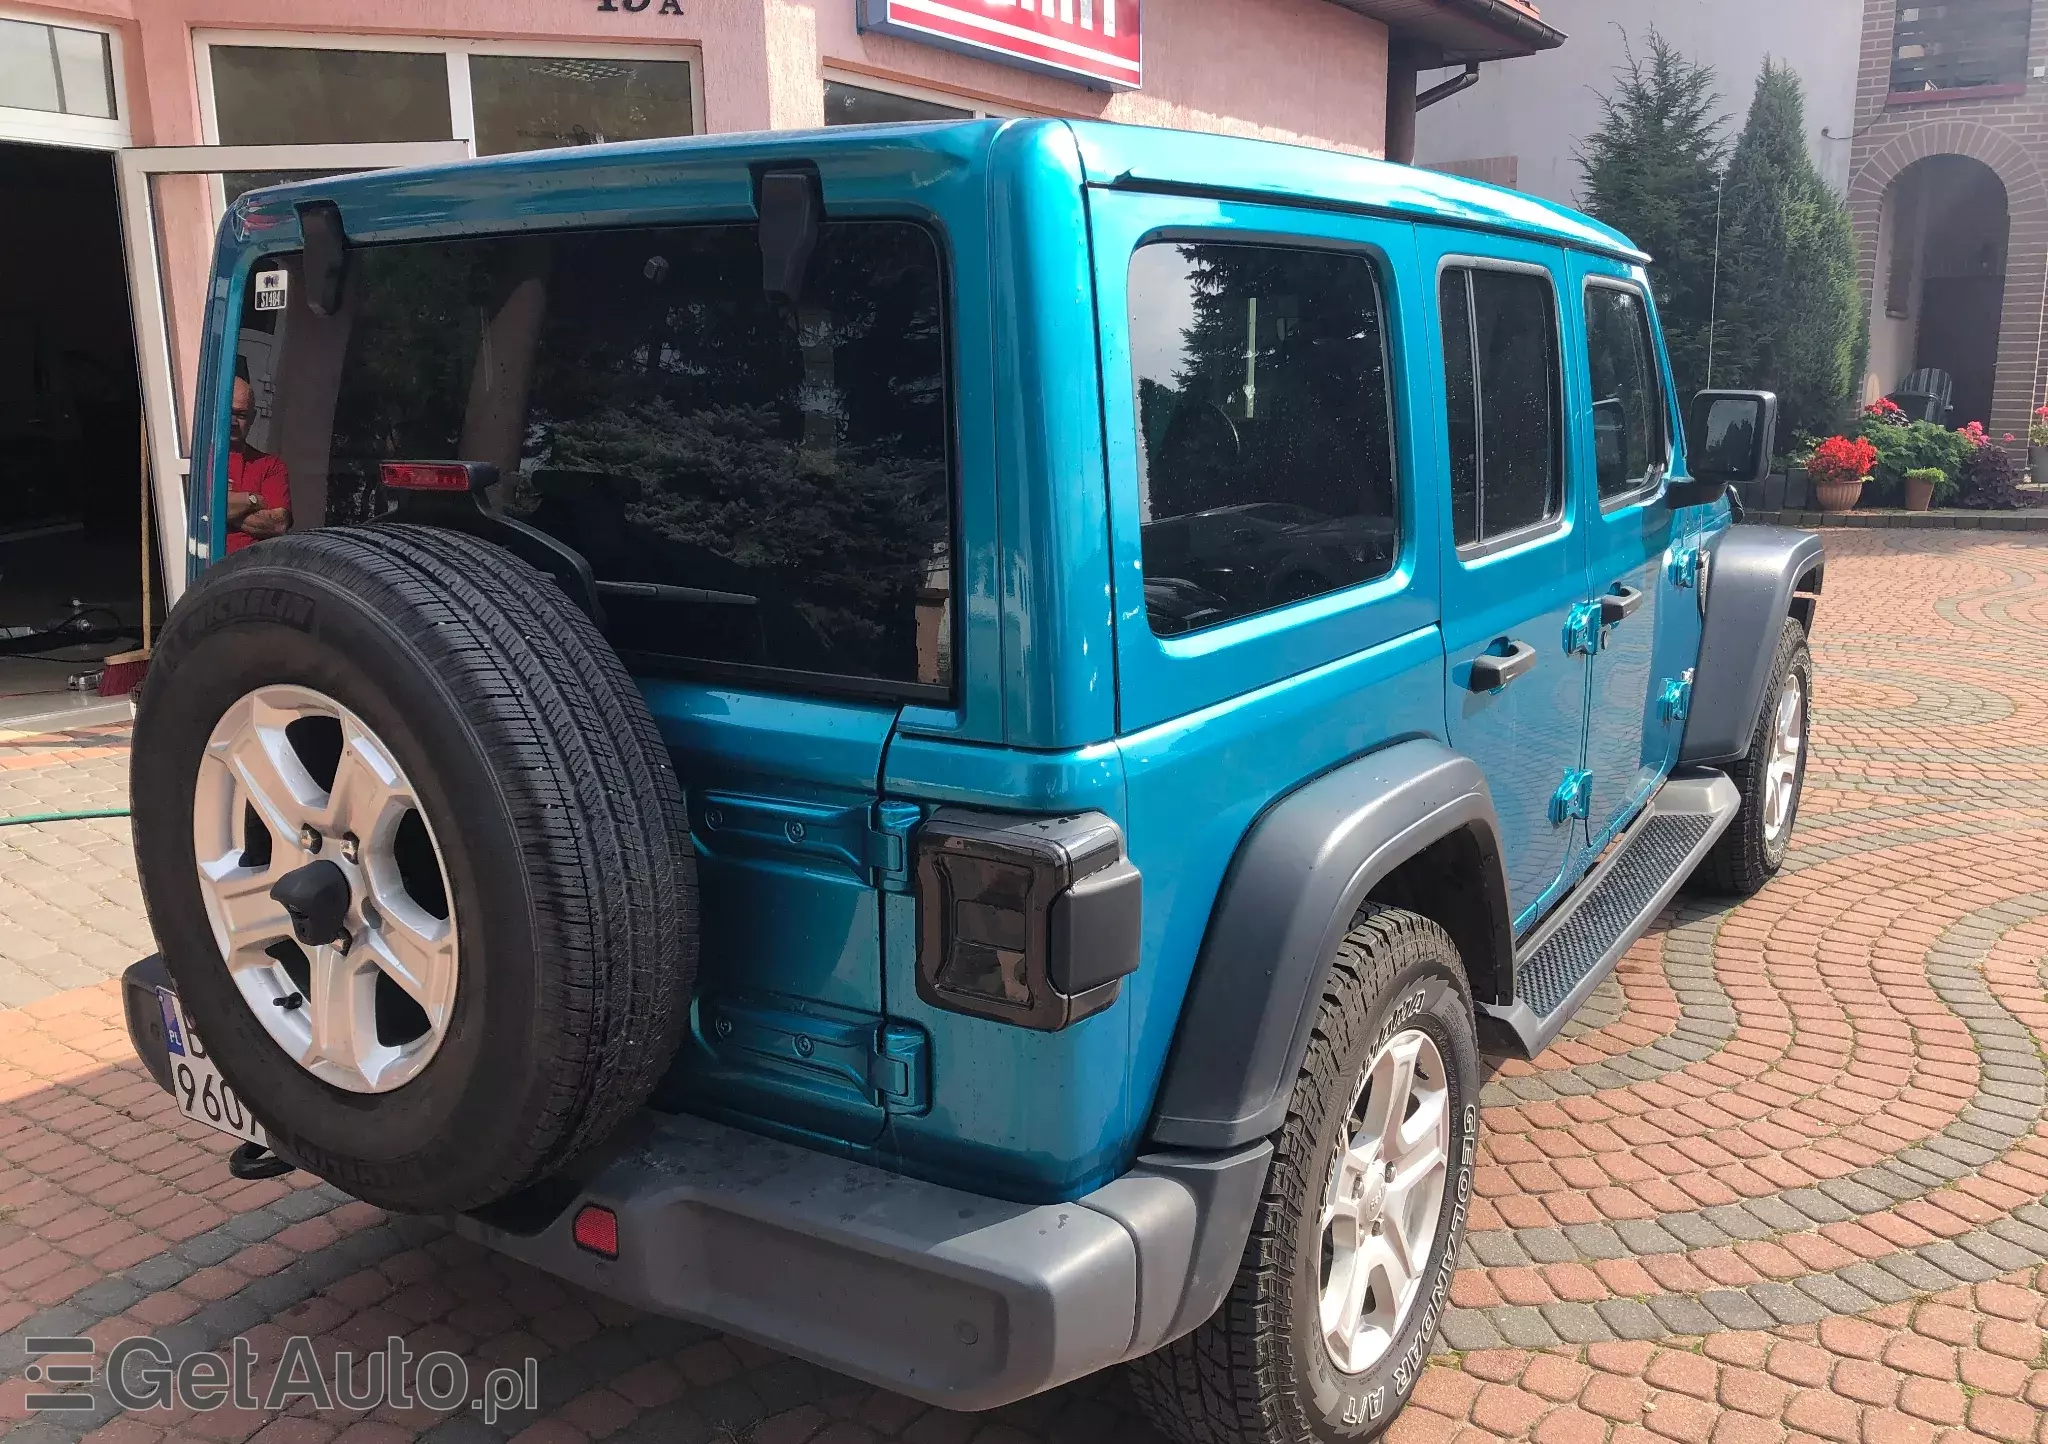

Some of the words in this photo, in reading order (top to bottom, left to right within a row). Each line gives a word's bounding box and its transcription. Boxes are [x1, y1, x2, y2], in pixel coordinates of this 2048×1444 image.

[169, 1029, 182, 1047] PL
[1393, 1103, 1477, 1396] GEOLANDAR
[1342, 1386, 1385, 1424] A/T
